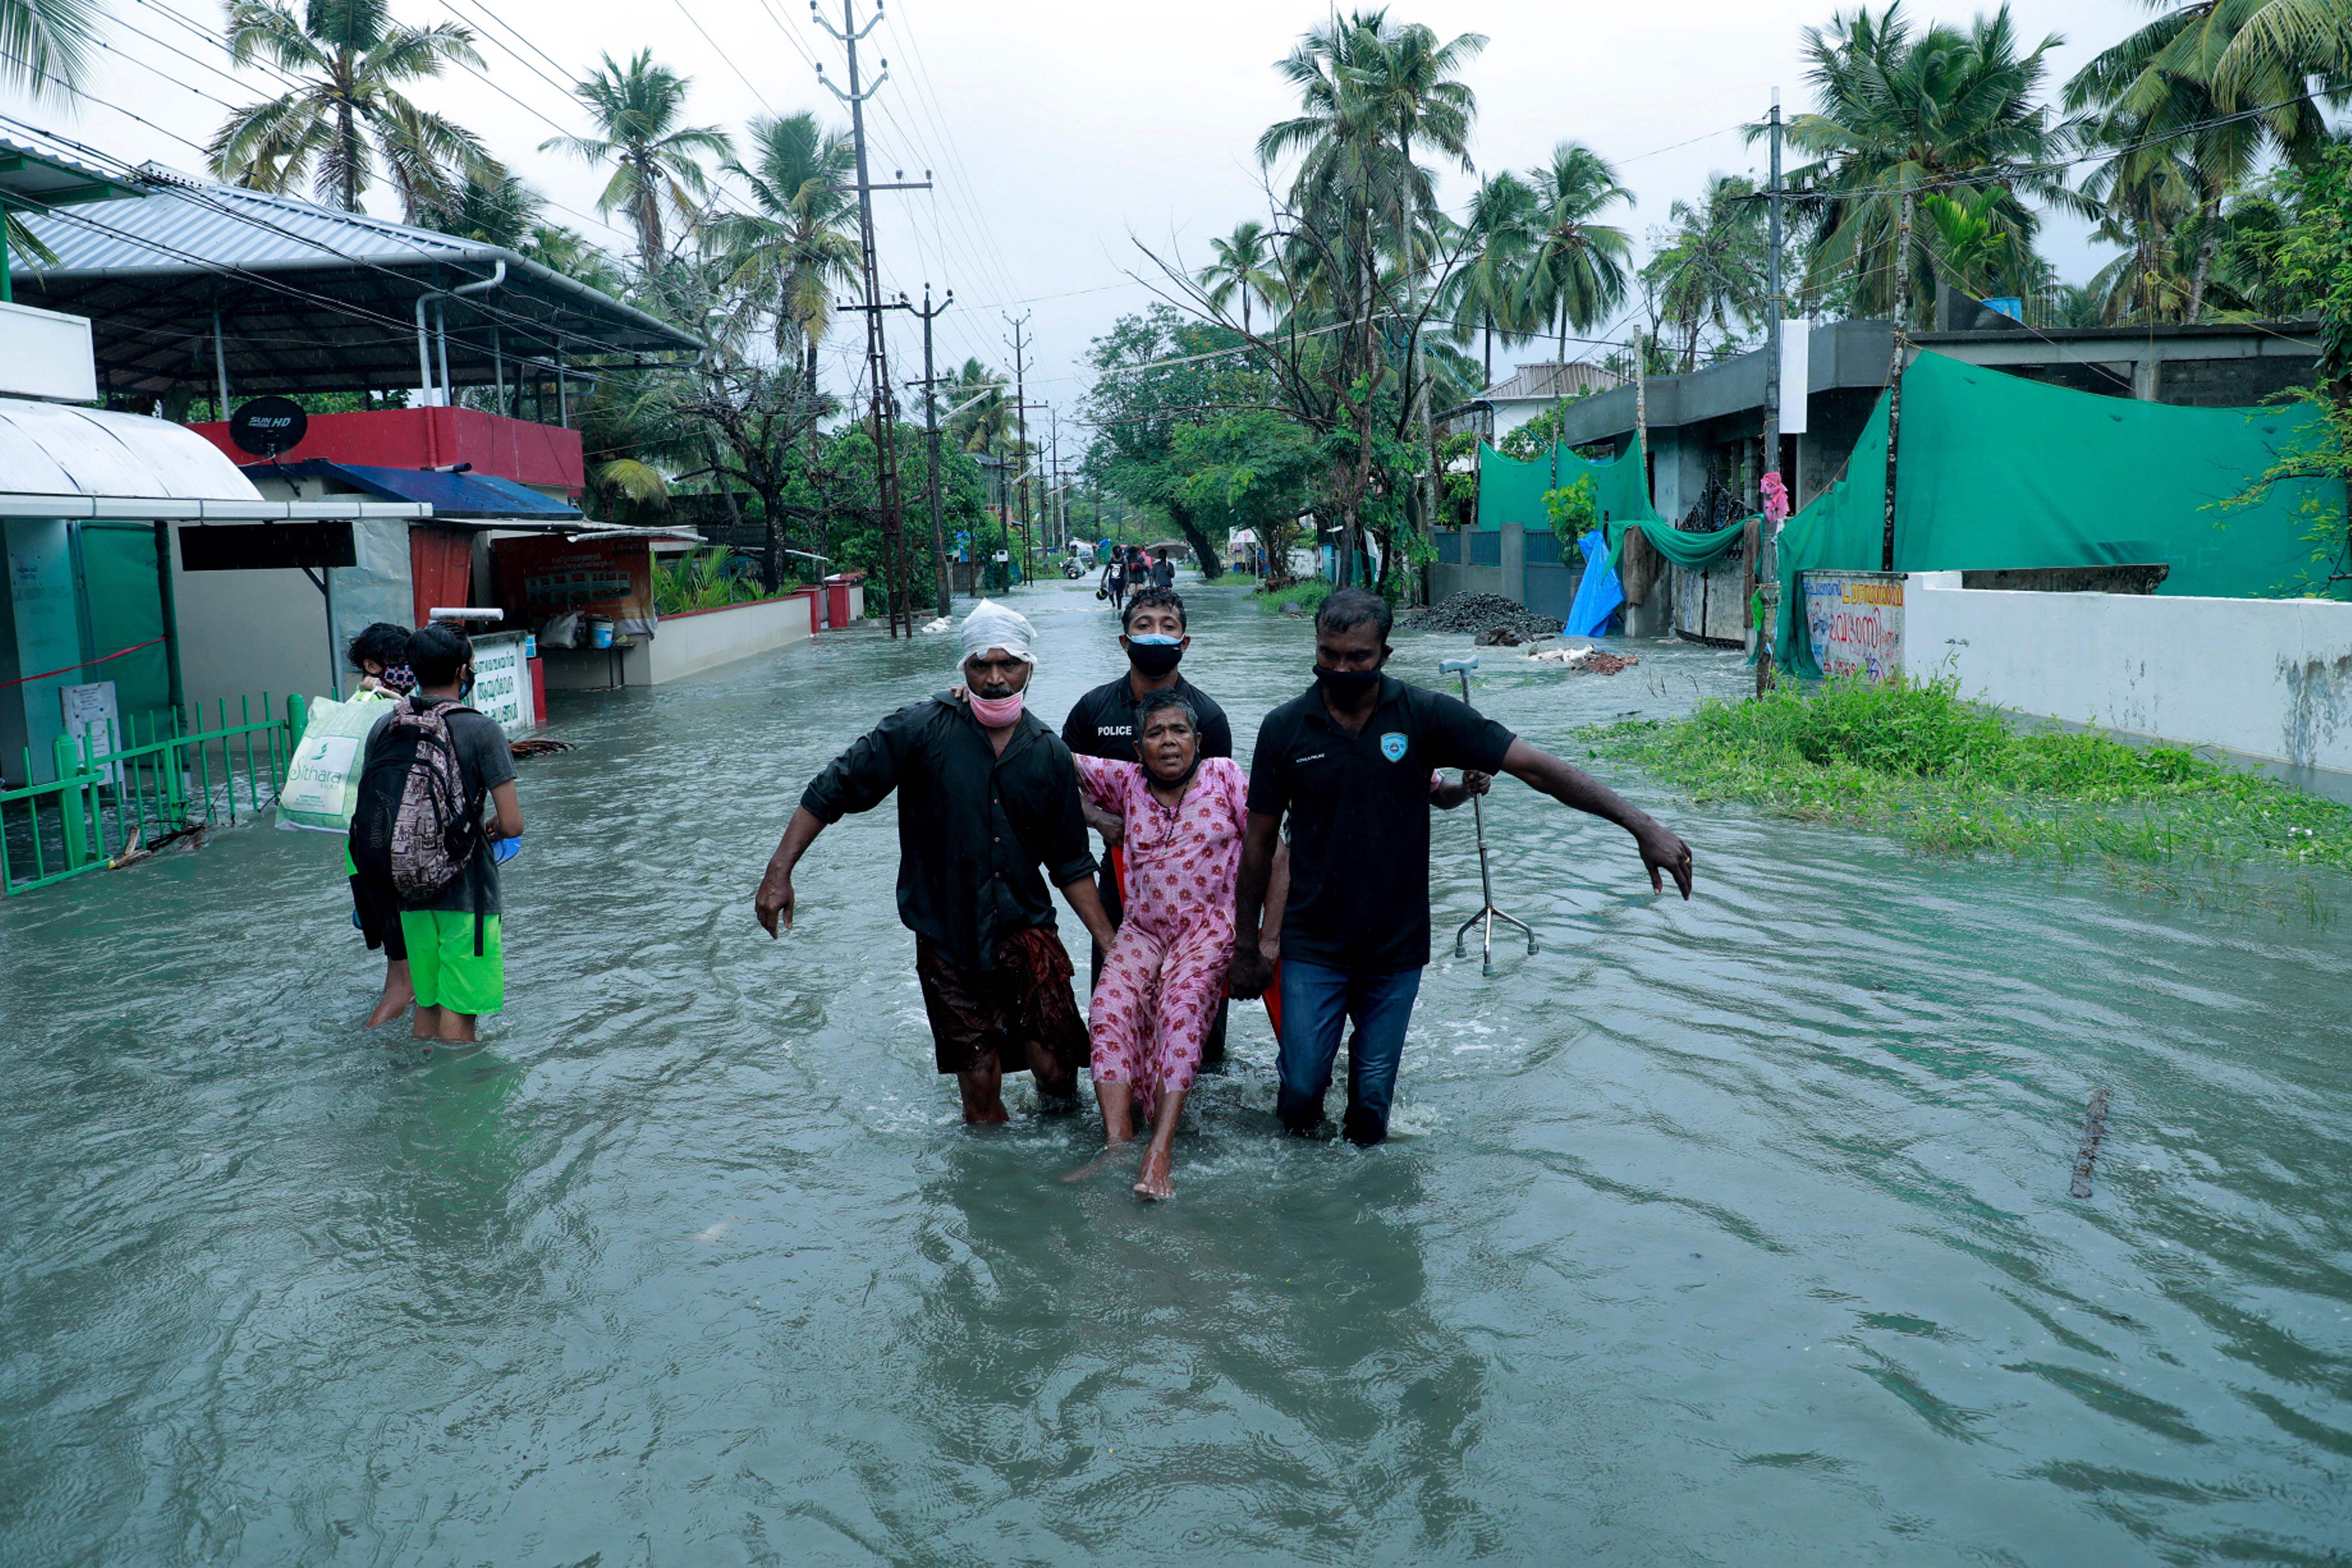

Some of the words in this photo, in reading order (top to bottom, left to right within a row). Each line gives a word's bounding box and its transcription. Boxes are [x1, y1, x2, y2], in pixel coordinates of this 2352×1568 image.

[271, 417, 291, 427] HD
[1098, 726, 1132, 736] POLICE
[289, 756, 342, 783] Sithara
